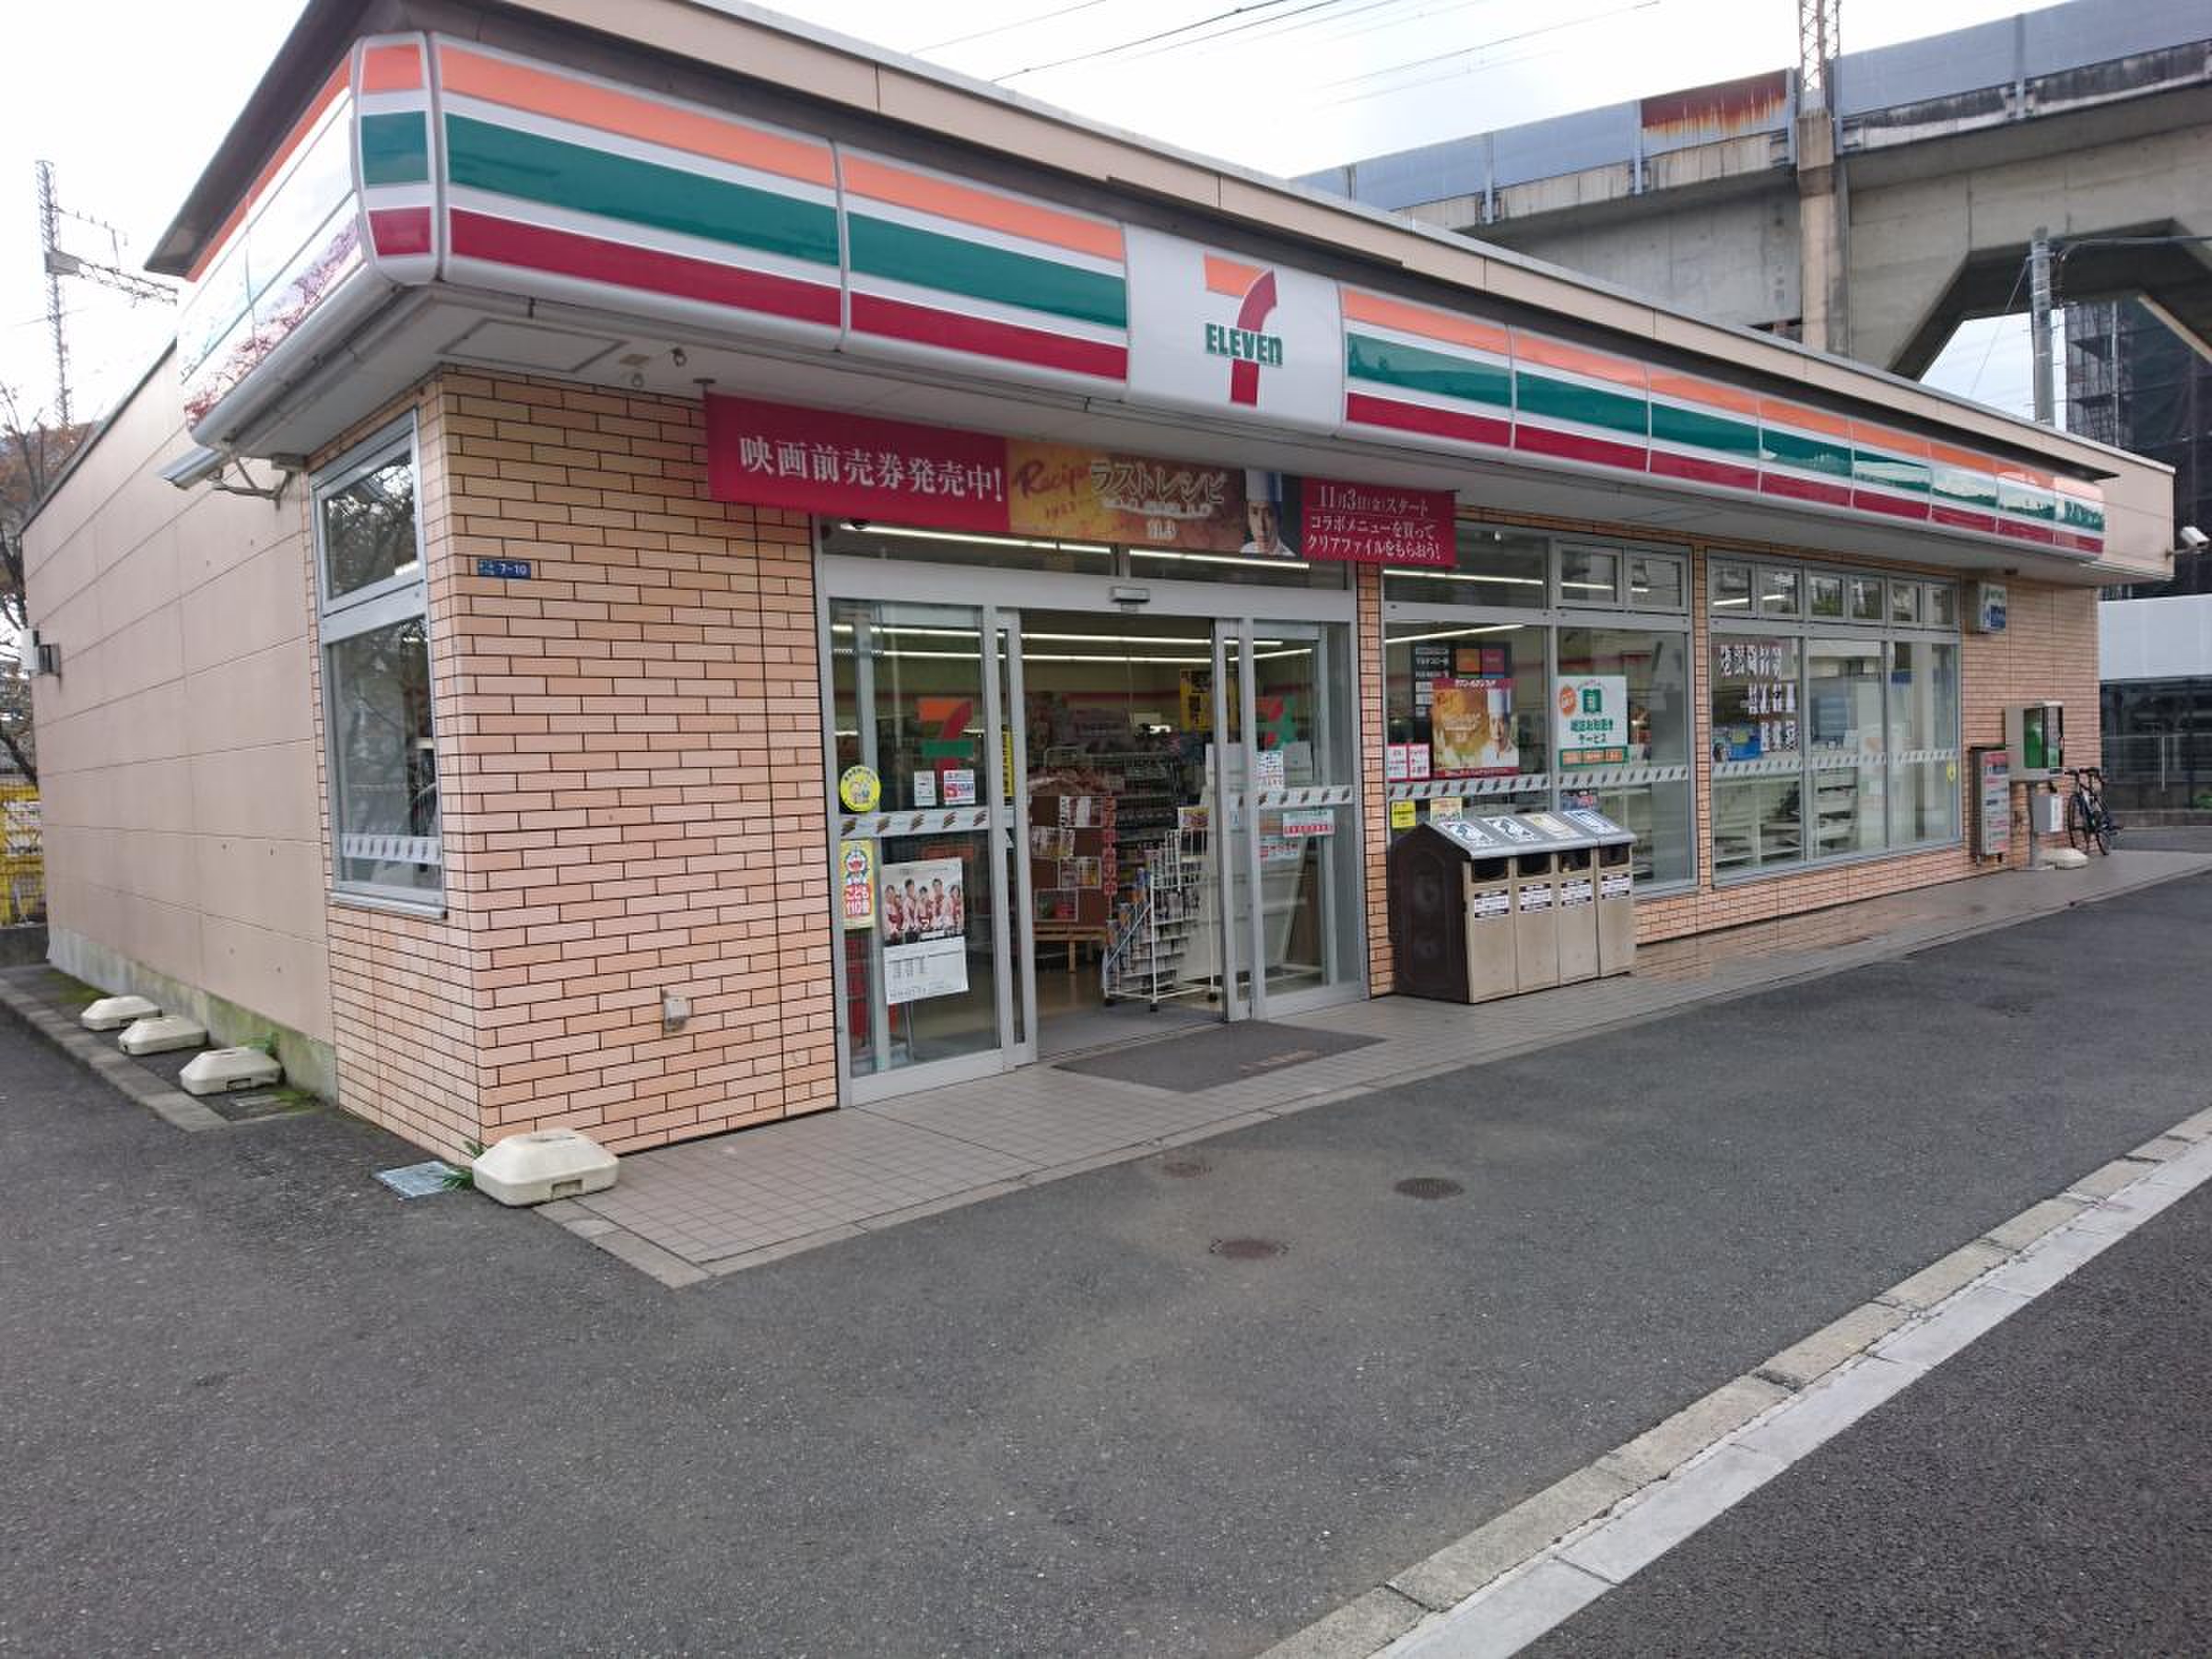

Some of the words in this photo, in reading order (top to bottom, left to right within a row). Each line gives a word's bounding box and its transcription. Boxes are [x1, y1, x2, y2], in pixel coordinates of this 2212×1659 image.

[738, 435, 1003, 502] 映画前売券発売中!
